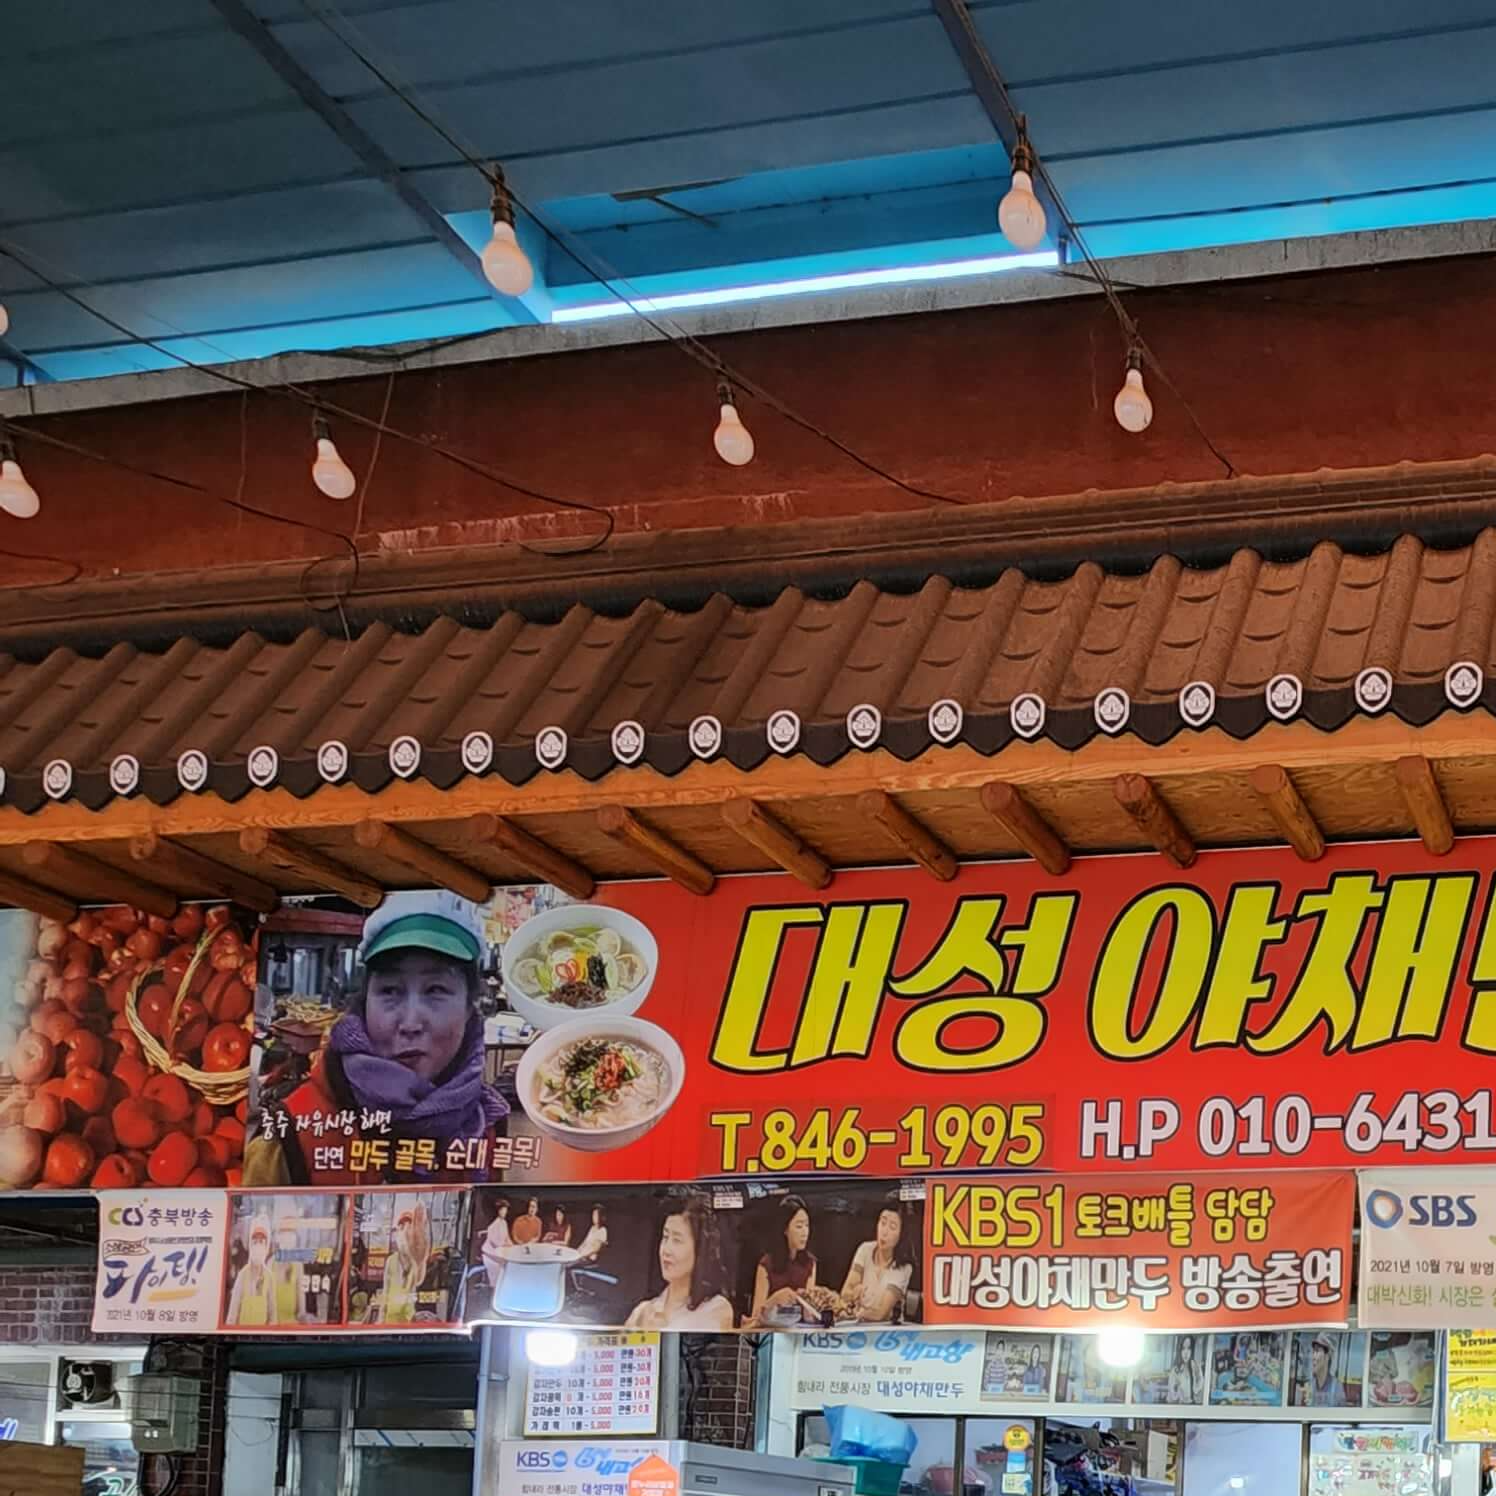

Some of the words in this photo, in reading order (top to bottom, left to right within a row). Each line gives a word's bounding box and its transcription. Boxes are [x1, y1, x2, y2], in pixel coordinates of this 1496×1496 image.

[711, 893, 1078, 1074] 대성
[262, 1111, 288, 1140] 충주
[295, 1113, 357, 1137] 자유시장
[360, 1109, 392, 1134] 하면
[710, 1104, 1046, 1174] T.846-1995
[1079, 1099, 1180, 1160] H.P
[314, 1146, 343, 1170] 단연
[350, 1140, 390, 1172] 만두
[446, 1138, 488, 1170] 순대
[492, 1136, 540, 1169] 골목!
[147, 1208, 214, 1226] 충북방송
[932, 1184, 1065, 1248] KBS1
[1076, 1184, 1195, 1246] 토크배틀
[1205, 1188, 1274, 1243] 담담
[1409, 1195, 1477, 1227] SBS
[933, 1255, 1169, 1311] 대성야채만두
[1180, 1248, 1341, 1311] 방송출연
[1370, 1260, 1410, 1274] 2021년
[1415, 1260, 1440, 1274] 10월
[1446, 1261, 1465, 1275] 7일
[1470, 1261, 1495, 1275] 방영
[1367, 1284, 1432, 1308] 대박신화!
[1439, 1284, 1484, 1308] 시장은
[803, 1332, 843, 1349] KBS
[829, 1381, 871, 1395] 전통시장
[877, 1381, 964, 1398] 대성야채만두
[516, 1451, 549, 1467] KBS
[596, 1457, 644, 1476] 내고
[582, 1482, 627, 1495] 대성야채
